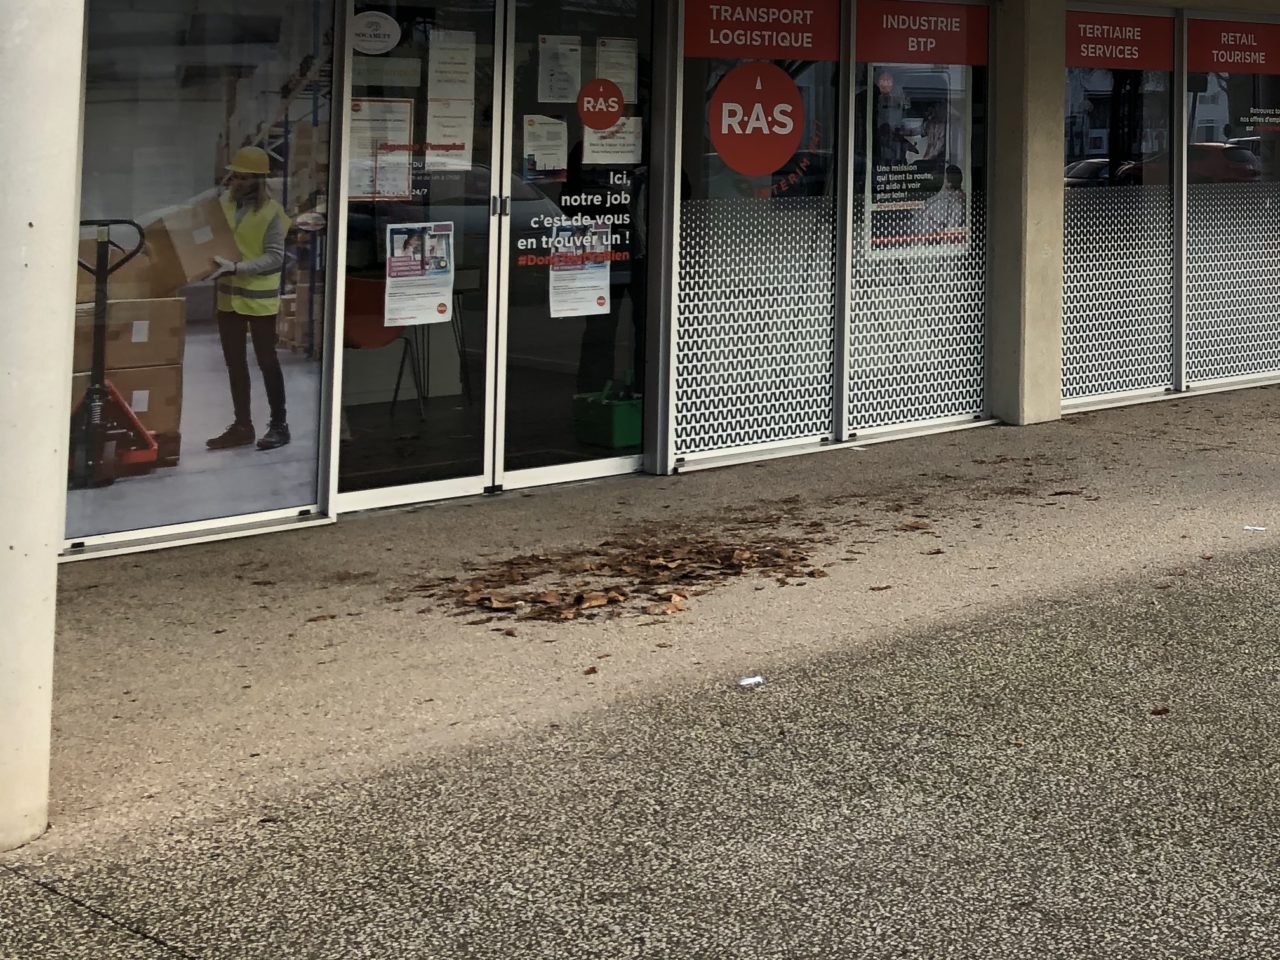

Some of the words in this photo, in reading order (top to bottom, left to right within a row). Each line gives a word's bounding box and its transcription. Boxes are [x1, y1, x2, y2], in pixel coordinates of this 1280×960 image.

[709, 5, 814, 25] TRANSPORT
[882, 14, 961, 32] INDUSTRIE
[709, 29, 813, 48] LOGISTIQUE
[1078, 24, 1142, 41] TERTIAIRE
[1220, 32, 1258, 47] RETAIL
[907, 37, 936, 52] BTP
[1080, 43, 1139, 60] SERVICES
[1212, 49, 1266, 65] TOURISME
[609, 170, 631, 186] Ici,
[561, 192, 602, 206] notre
[606, 190, 631, 207] job
[571, 212, 591, 226] de
[595, 213, 631, 225] vous
[517, 238, 537, 249] en
[541, 233, 598, 248] trouver
[602, 233, 621, 245] un
